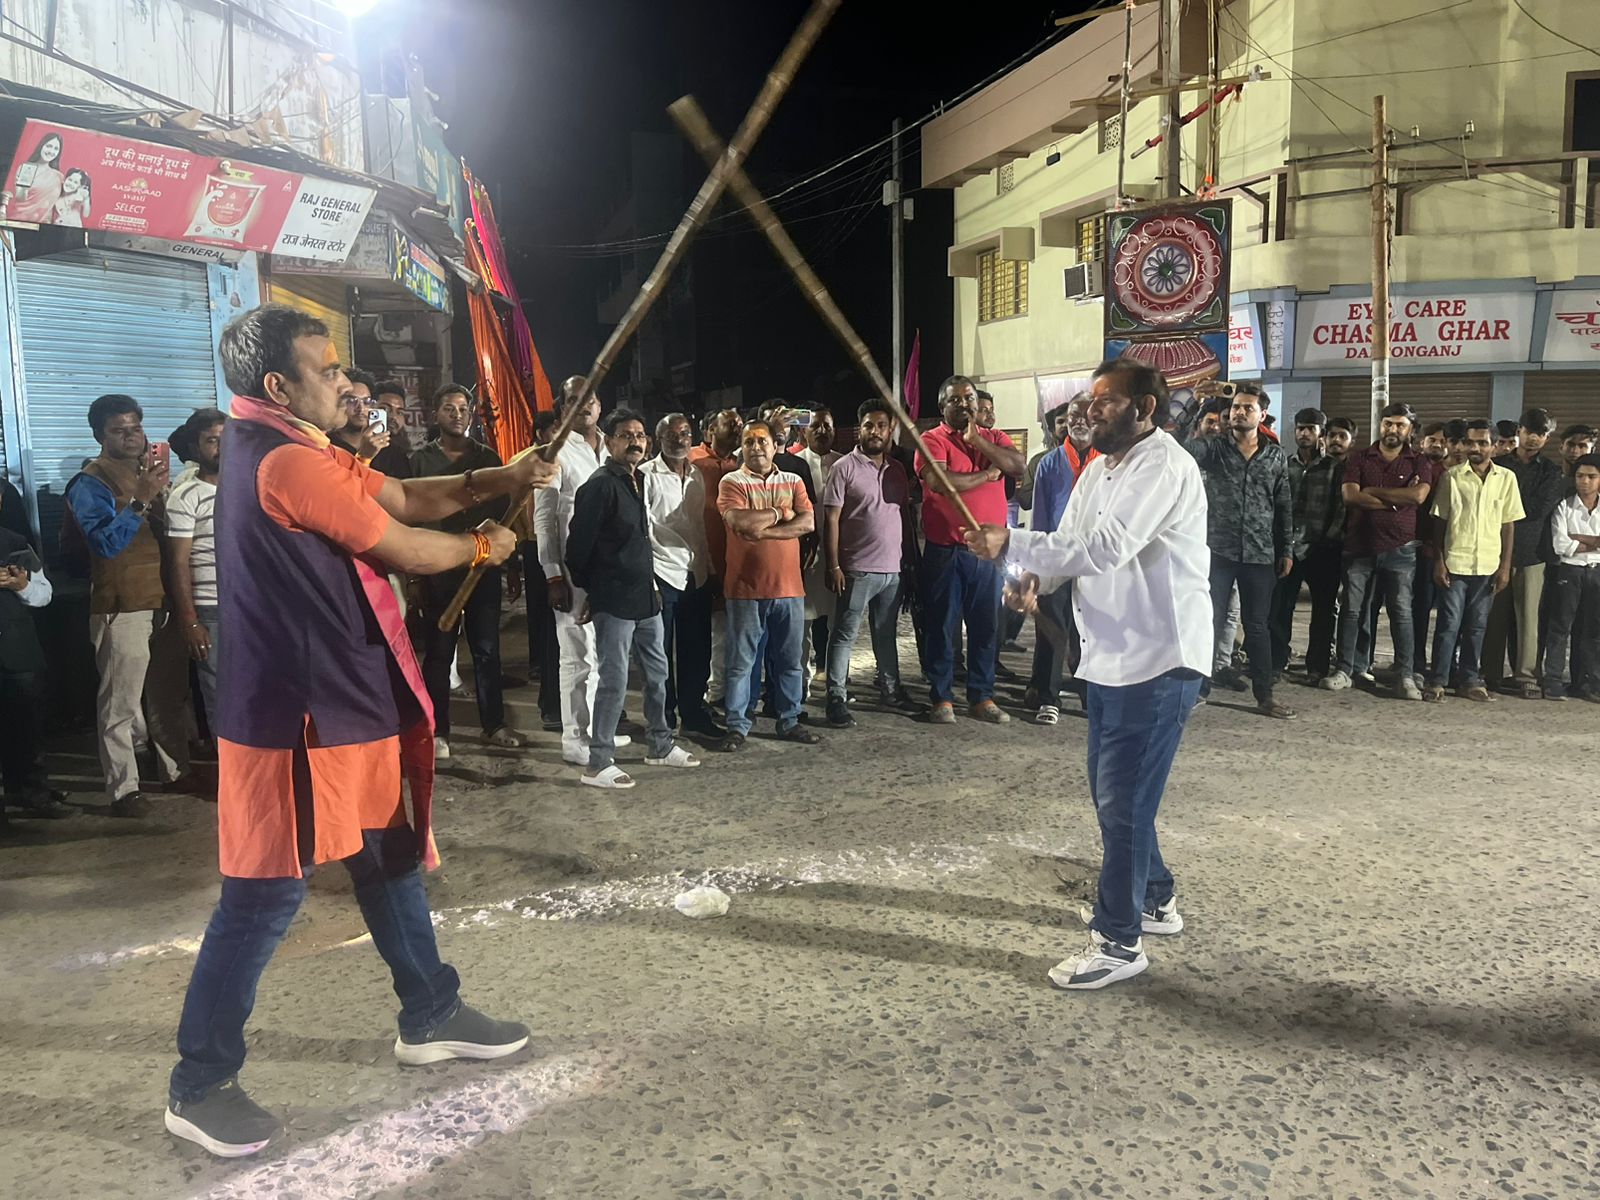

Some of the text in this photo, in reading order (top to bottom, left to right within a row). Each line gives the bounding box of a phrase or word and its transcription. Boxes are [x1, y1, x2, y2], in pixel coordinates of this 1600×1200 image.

[122, 148, 135, 160] की
[113, 202, 147, 214] SELECT
[300, 192, 362, 213] RAJ GENERAL
[311, 208, 343, 222] STORE
[281, 233, 347, 253] राज जेनरल स्टोर
[172, 244, 225, 260] GENERAL
[1347, 299, 1467, 321] EY CARE
[1437, 319, 1511, 342] GHAR
[1345, 345, 1463, 359] DAONGANJ
